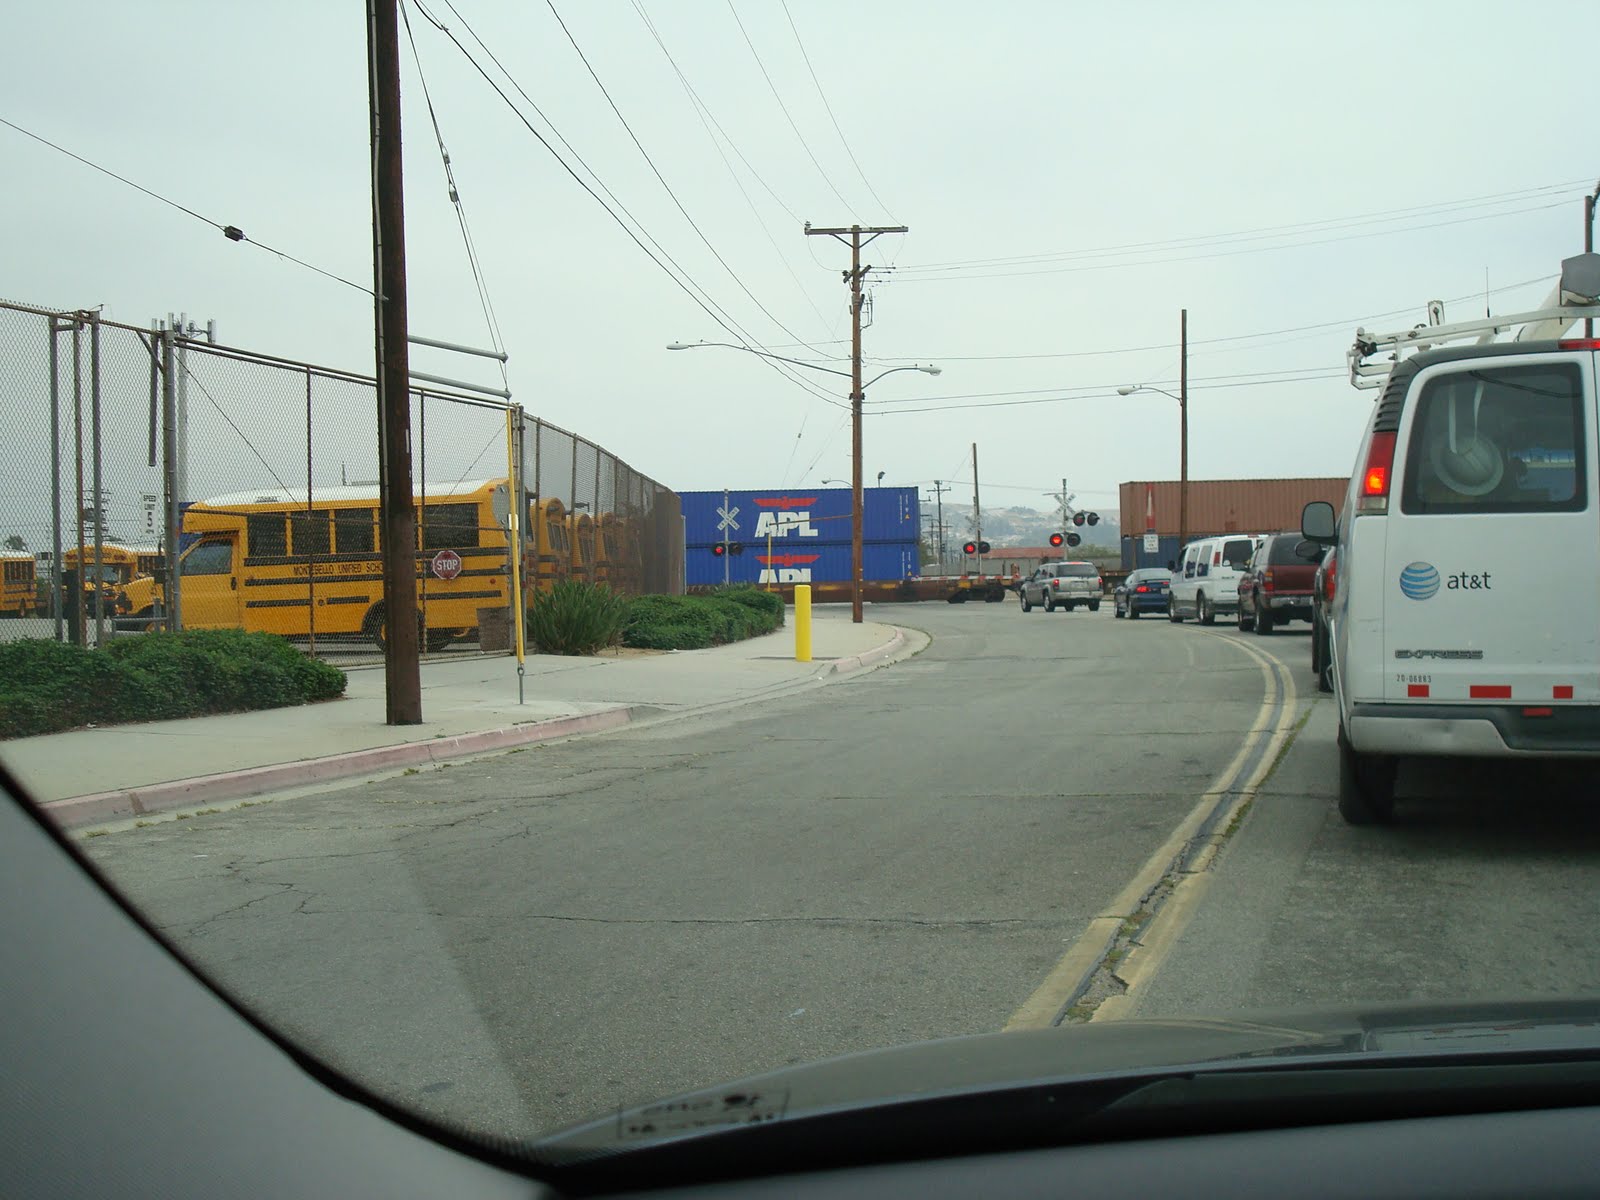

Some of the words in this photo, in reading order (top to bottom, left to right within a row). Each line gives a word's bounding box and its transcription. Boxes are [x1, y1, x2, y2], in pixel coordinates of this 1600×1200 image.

[146, 511, 153, 527] 5
[754, 511, 819, 537] APL
[338, 563, 362, 574] UNIFIED
[366, 562, 384, 573] SCHO
[436, 560, 459, 571] STOP
[1447, 571, 1492, 590] at&t
[1394, 649, 1484, 660] EXPRESS
